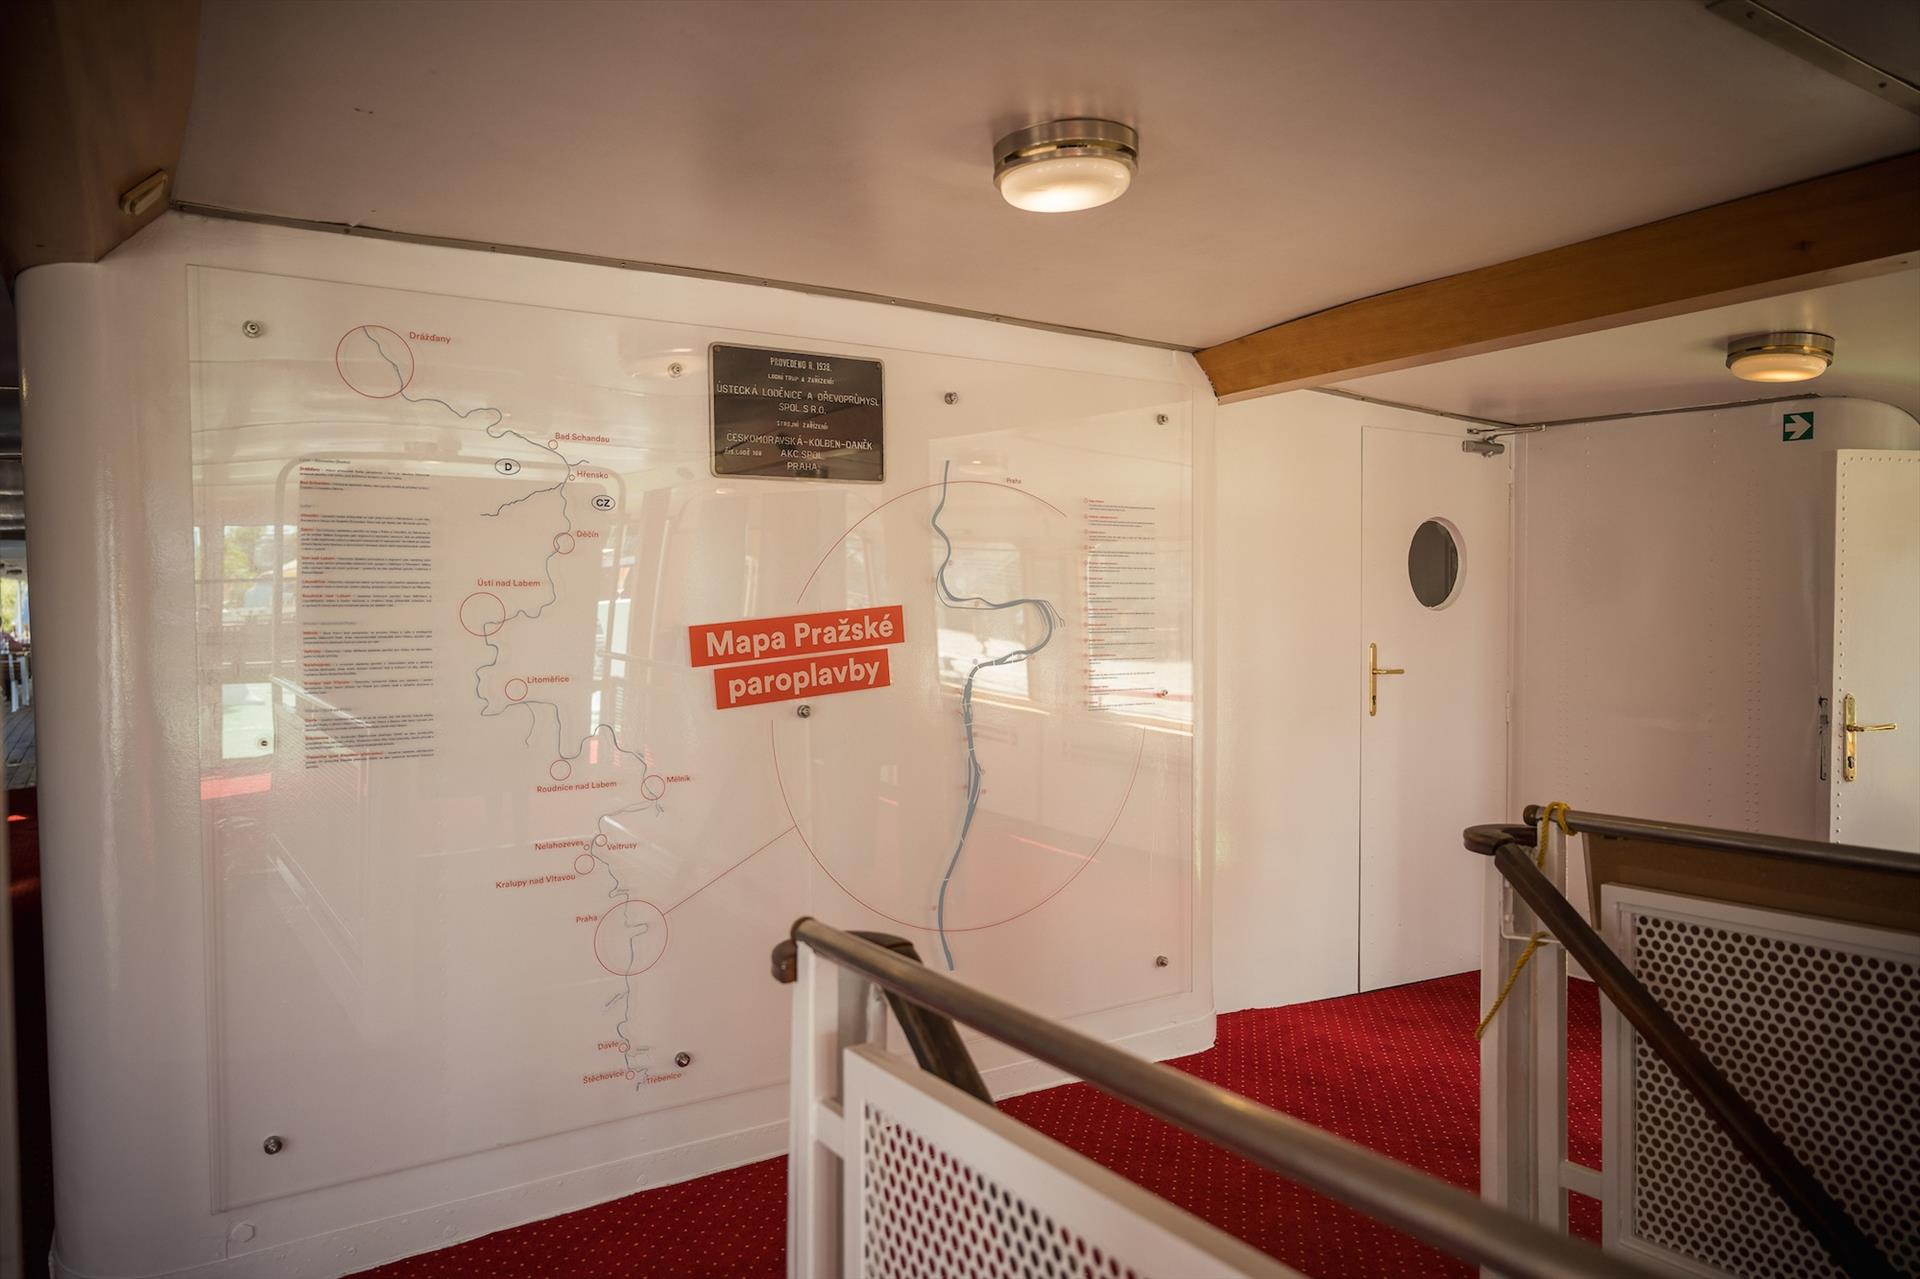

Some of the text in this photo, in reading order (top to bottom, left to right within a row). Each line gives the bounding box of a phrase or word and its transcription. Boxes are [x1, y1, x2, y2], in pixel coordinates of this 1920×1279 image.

[408, 331, 451, 344] Drážďany
[769, 357, 807, 369] PROVEDENO
[716, 380, 880, 406] ÚSTECKÁ LODĚNICE A DŘEVOPRŮMYSL
[555, 432, 610, 443] Bad Schandau
[504, 462, 513, 471] D
[577, 470, 608, 479] Hřensko
[596, 498, 610, 507] CZ
[576, 530, 599, 538] Děčín
[477, 577, 541, 587] Ústí nad Labem
[706, 613, 894, 658] Mapa Pražské
[527, 676, 570, 684] Litoměřice
[728, 658, 880, 704] paroplavby
[666, 774, 691, 783] Mělník
[536, 780, 617, 793] Roudnice nad Labem
[535, 839, 584, 850] Nelahozeves
[607, 841, 638, 851] Veltrusy
[495, 874, 576, 889] Kralupy nad Vltavou
[576, 915, 598, 923] Praha
[597, 1040, 619, 1050] Davle
[583, 1069, 625, 1084] Štěchovice
